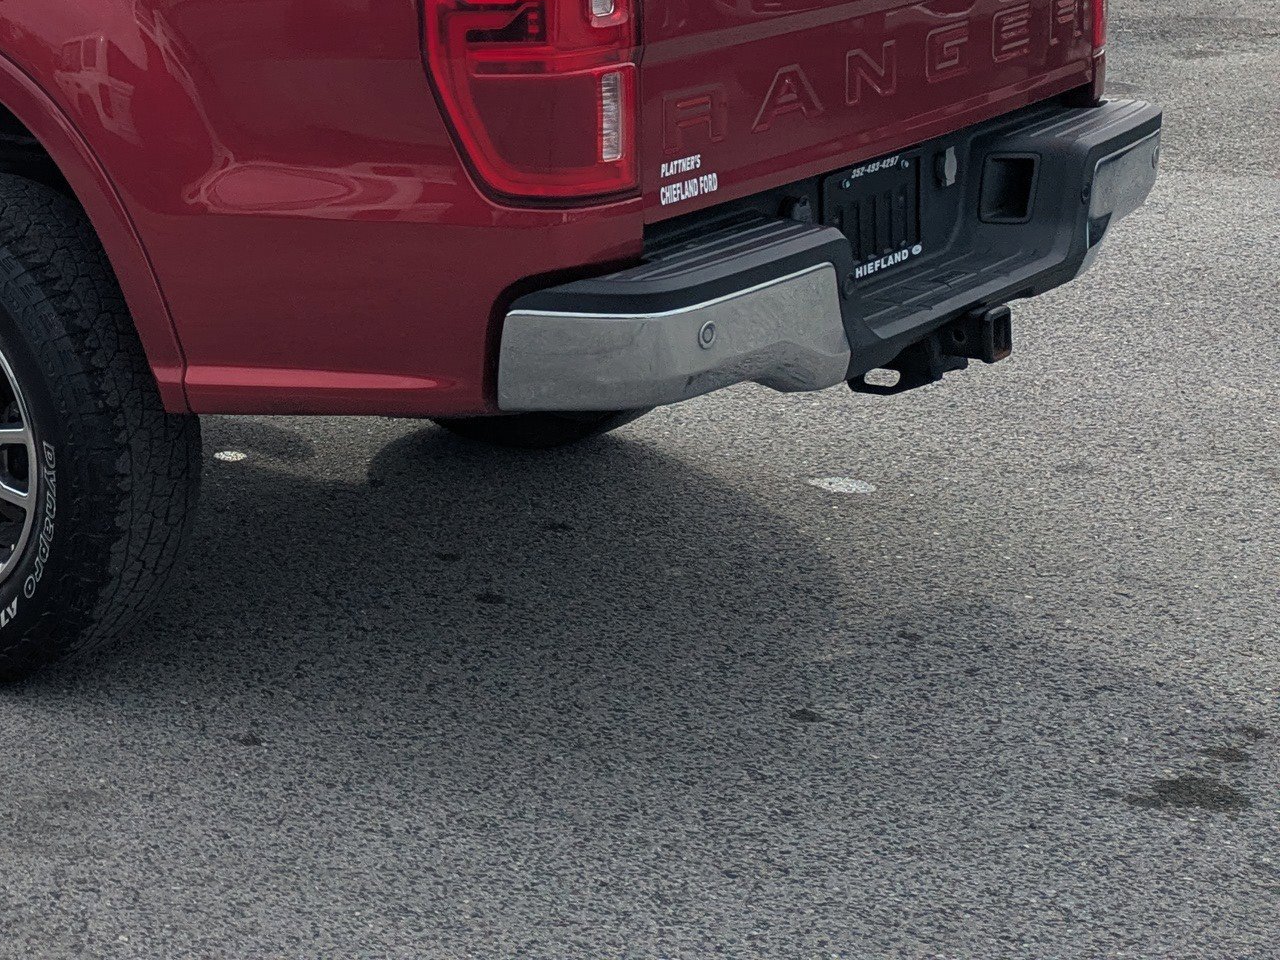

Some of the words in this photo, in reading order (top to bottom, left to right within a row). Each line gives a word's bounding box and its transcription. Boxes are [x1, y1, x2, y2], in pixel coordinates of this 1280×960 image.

[660, 153, 701, 178] PLATTNER'S
[660, 178, 699, 206] CHIEFLAND
[699, 172, 718, 195] FORD
[854, 248, 909, 279] HIEFLAND
